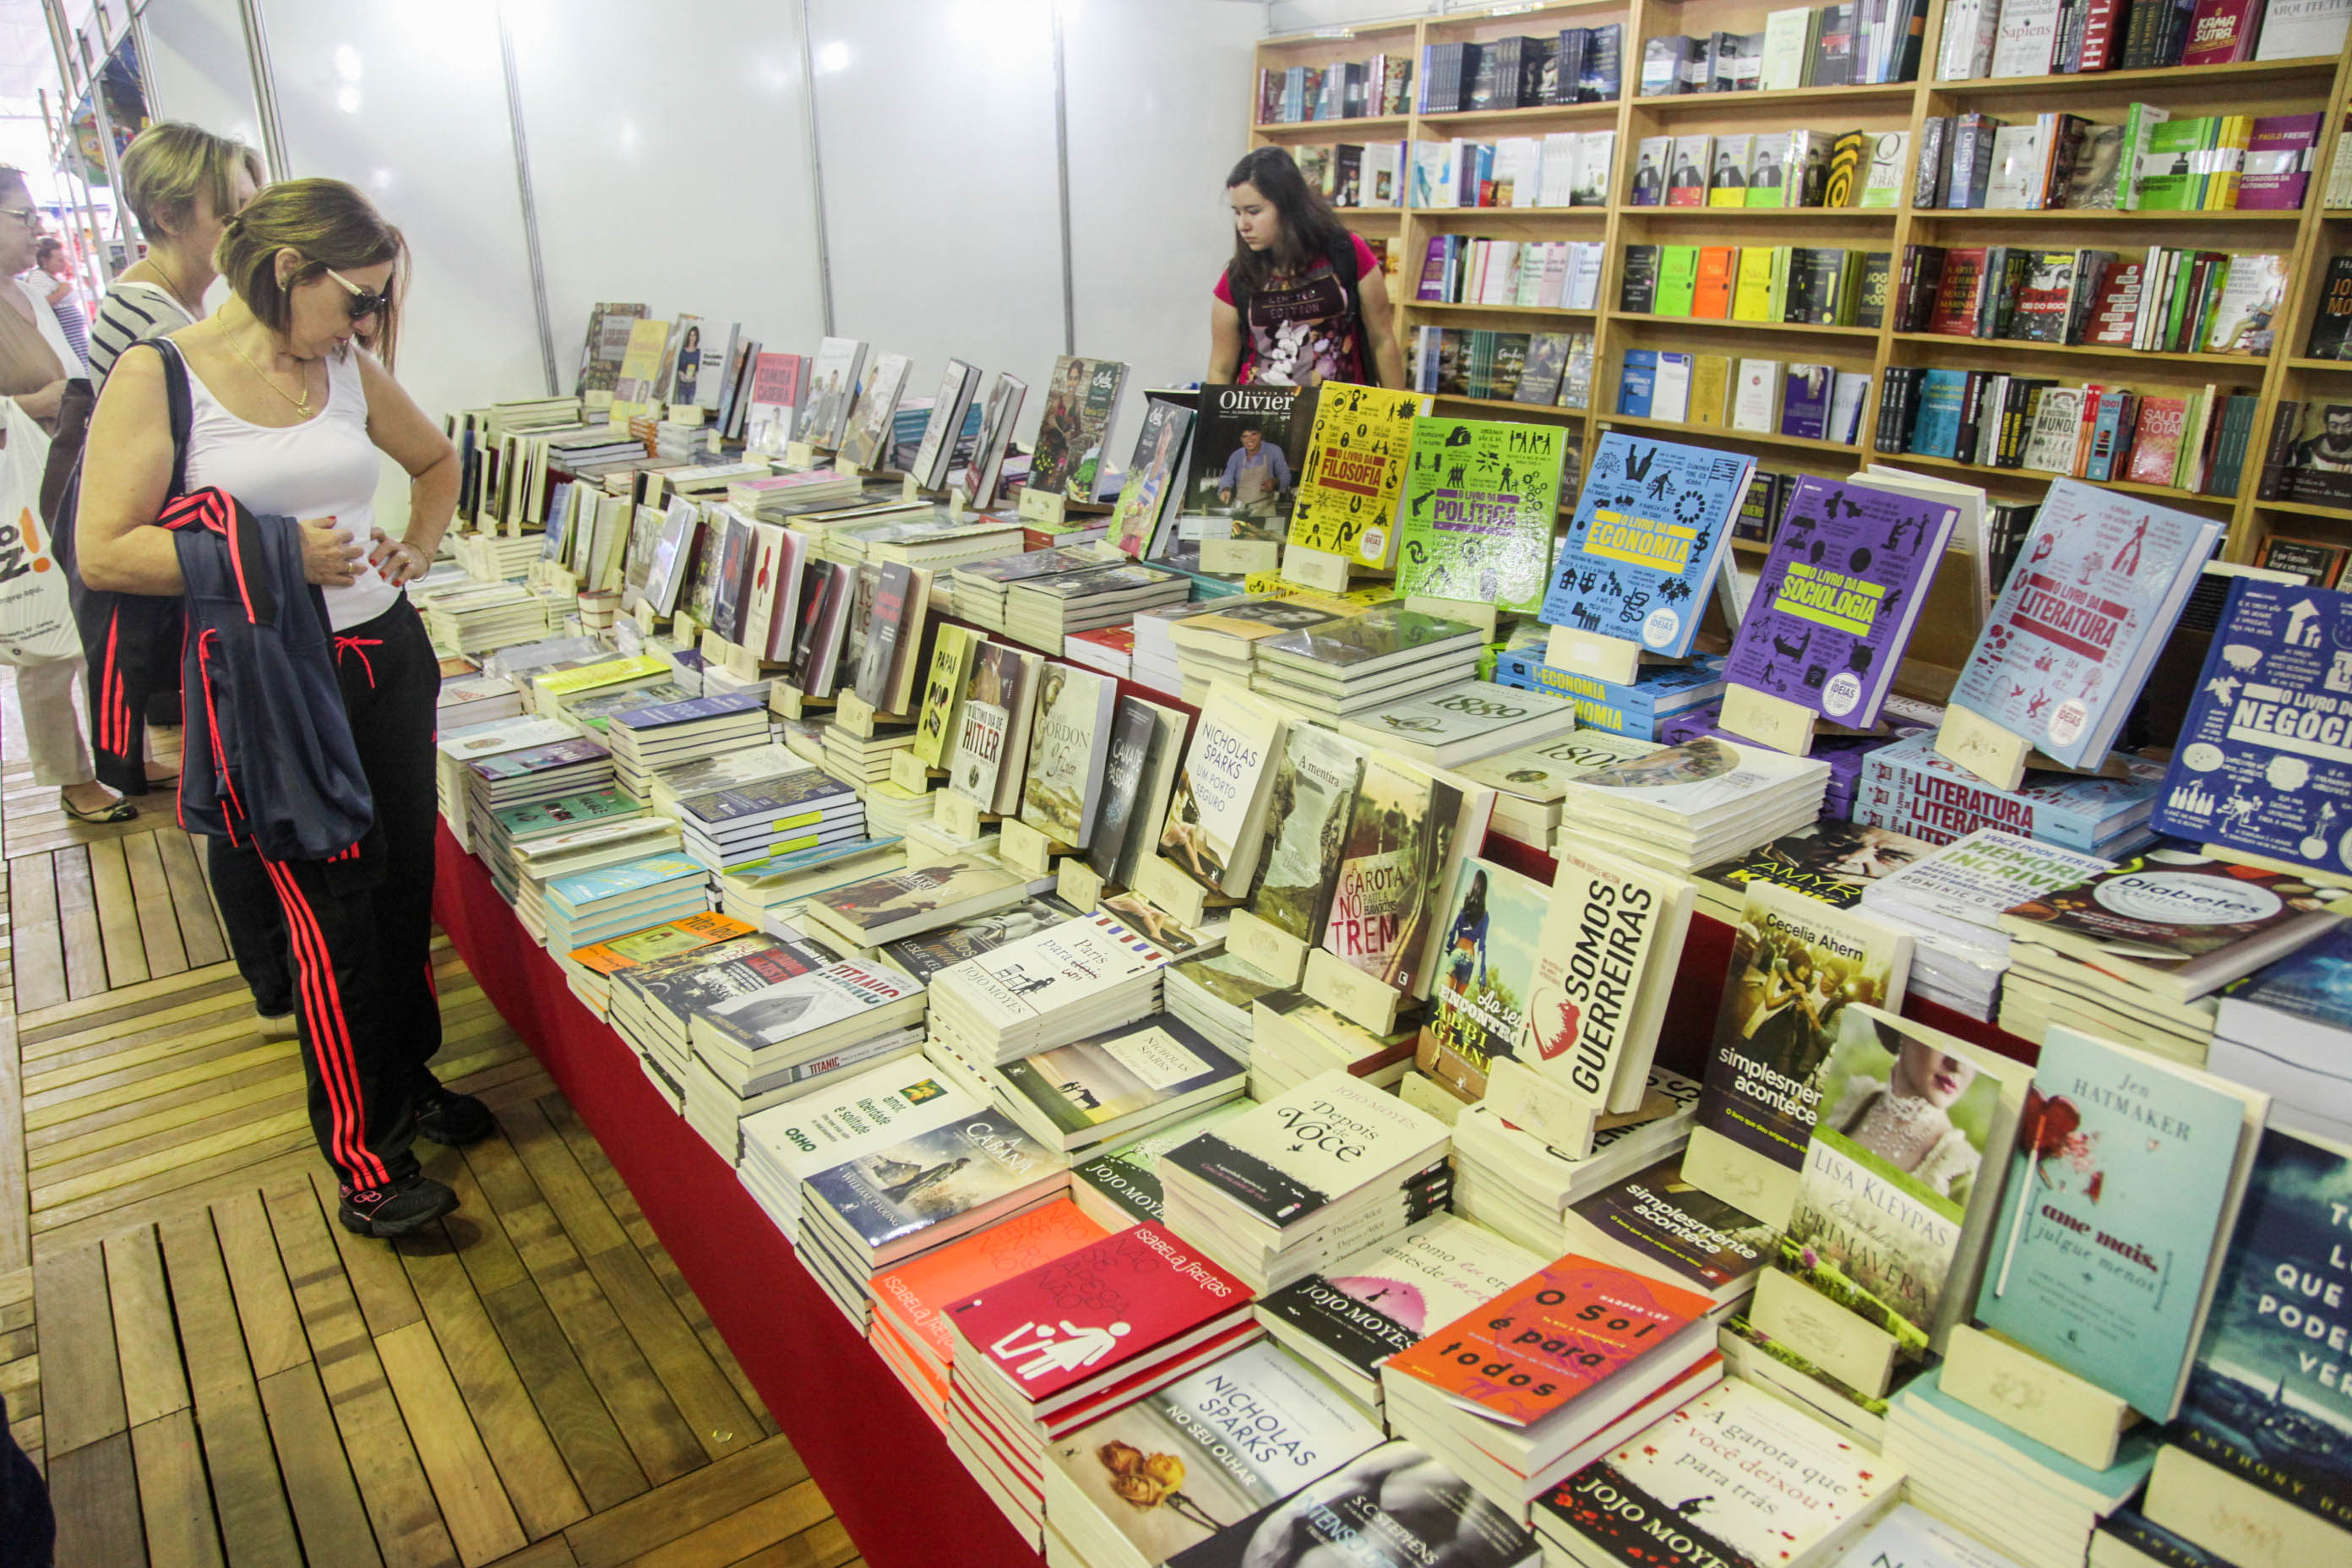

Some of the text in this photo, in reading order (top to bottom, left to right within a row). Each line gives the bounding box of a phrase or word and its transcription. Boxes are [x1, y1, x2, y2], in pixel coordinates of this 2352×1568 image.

[2001, 23, 2051, 39] Sapiens
[2195, 27, 2235, 41] SUTRA
[2197, 14, 2237, 30] KAMA
[2257, 131, 2311, 141] PAULO FREIRE
[1270, 302, 1321, 321] EDITION
[1220, 390, 1295, 411] Olivier
[1321, 458, 1382, 487] FILOSOFIA
[1343, 449, 1364, 462] LIVRO
[1364, 455, 1374, 465] DA
[1434, 498, 1516, 527] POLÍTICA
[1465, 490, 1485, 501] LIVRO
[1486, 493, 1497, 503] DA
[1628, 515, 1655, 531] LIVRO
[1655, 521, 1669, 533] DA
[1587, 520, 1690, 564] ECONOMIA
[1816, 569, 1844, 588] LIVRO
[1845, 576, 1858, 591] DA
[2060, 582, 2088, 607] LIVRO
[2088, 593, 2100, 611] DA
[1779, 574, 1879, 624] SOCIOLOGIA
[1650, 618, 1674, 631] IDEIAS
[2017, 587, 2120, 649] LITERATURA
[935, 650, 957, 674] PAPAI
[1541, 667, 1607, 701] ECONOMIA
[1831, 683, 1856, 700] IDEIAS
[1430, 693, 1528, 721] 1889
[2058, 709, 2082, 728] IDEIAS
[2281, 689, 2336, 714] O LIVRO
[962, 718, 1000, 765] HITLER
[1038, 718, 1091, 749] GORDON
[1202, 722, 1259, 768] NICHOLAS
[1204, 743, 1243, 780] SPARKS
[1298, 754, 1341, 789] A mentira
[1195, 782, 1226, 813] SEGURO
[1196, 765, 1237, 799] UM PORTO
[1914, 771, 2034, 830] LITERATURA
[2023, 844, 2085, 868] PODE TER
[1345, 864, 1406, 896] GAROTA
[1750, 862, 1862, 900] AMYR
[1900, 874, 1969, 899] DOMINIC
[2120, 877, 2264, 915] Diabetes
[1339, 894, 1362, 923] NO
[1362, 891, 1389, 905] PAULA
[1363, 900, 1399, 917] HAWKINS
[901, 939, 928, 960] LESLIE
[1037, 939, 1074, 961] para
[1331, 912, 1400, 956] TREM
[1564, 879, 1616, 1004] SOMOS
[1766, 912, 1816, 944] Cecelia
[1818, 934, 1865, 962] Ahern
[1074, 939, 1109, 965] Paris
[957, 966, 1026, 1015] JOJO MOYES
[1060, 966, 1083, 982] um
[1571, 882, 1652, 1095] GUERREIRAS
[1438, 983, 1519, 1046] ENCONTRO
[1477, 989, 1501, 1014] Ao
[1434, 1002, 1488, 1048] ABBI
[808, 1056, 841, 1076] TITANIC
[1141, 1045, 1171, 1072] SPARKS
[1147, 1036, 1191, 1072] NICHOLAS
[1734, 1075, 1818, 1127] acontece
[2117, 1074, 2151, 1098] Jen
[855, 1097, 892, 1128] liberdade
[881, 1095, 909, 1114] amor,
[1309, 1099, 1380, 1141] Depois
[1331, 1085, 1420, 1130] JOJO MOYES
[2072, 1077, 2192, 1142] HATMAKER
[838, 1109, 872, 1136] solitude
[785, 1127, 818, 1153] OSHO
[966, 1121, 1034, 1176] CABANA
[1006, 1135, 1024, 1148] A
[841, 1171, 902, 1228] WILLIAM YOUNG
[1086, 1162, 1165, 1225] JOJO MOYE
[1815, 1147, 1948, 1248] LISA KLEYPAS
[1625, 1183, 1758, 1260] simplesmente
[1631, 1203, 1722, 1255] acontece
[1407, 1233, 1455, 1263] Como
[2041, 1203, 2160, 1275] ame mais,
[1381, 1244, 1445, 1278] antes de
[1799, 1204, 1928, 1309] PRIMAVERA
[2034, 1222, 2156, 1294] julgue menos
[1296, 1282, 1349, 1312] JOJO
[1535, 1289, 1567, 1306] O
[2274, 1263, 2345, 1309] QUE
[1598, 1293, 1672, 1322] HARPER LEE
[1488, 1315, 1607, 1368] é para
[1440, 1340, 1559, 1397] todos
[2298, 1351, 2352, 1397] VER
[1198, 1397, 1278, 1464] SPARKS
[1205, 1374, 1317, 1468] NICHOLAS
[1166, 1404, 1258, 1487] NO SEU OLHAR
[1702, 1407, 1849, 1497] A garota que
[2190, 1429, 2305, 1495] ANTHONY
[1673, 1451, 1782, 1516] para trás
[1687, 1425, 1822, 1511] você deixou
[1574, 1477, 1647, 1522] JOJO
[1371, 1511, 1440, 1566] STEPHENS
